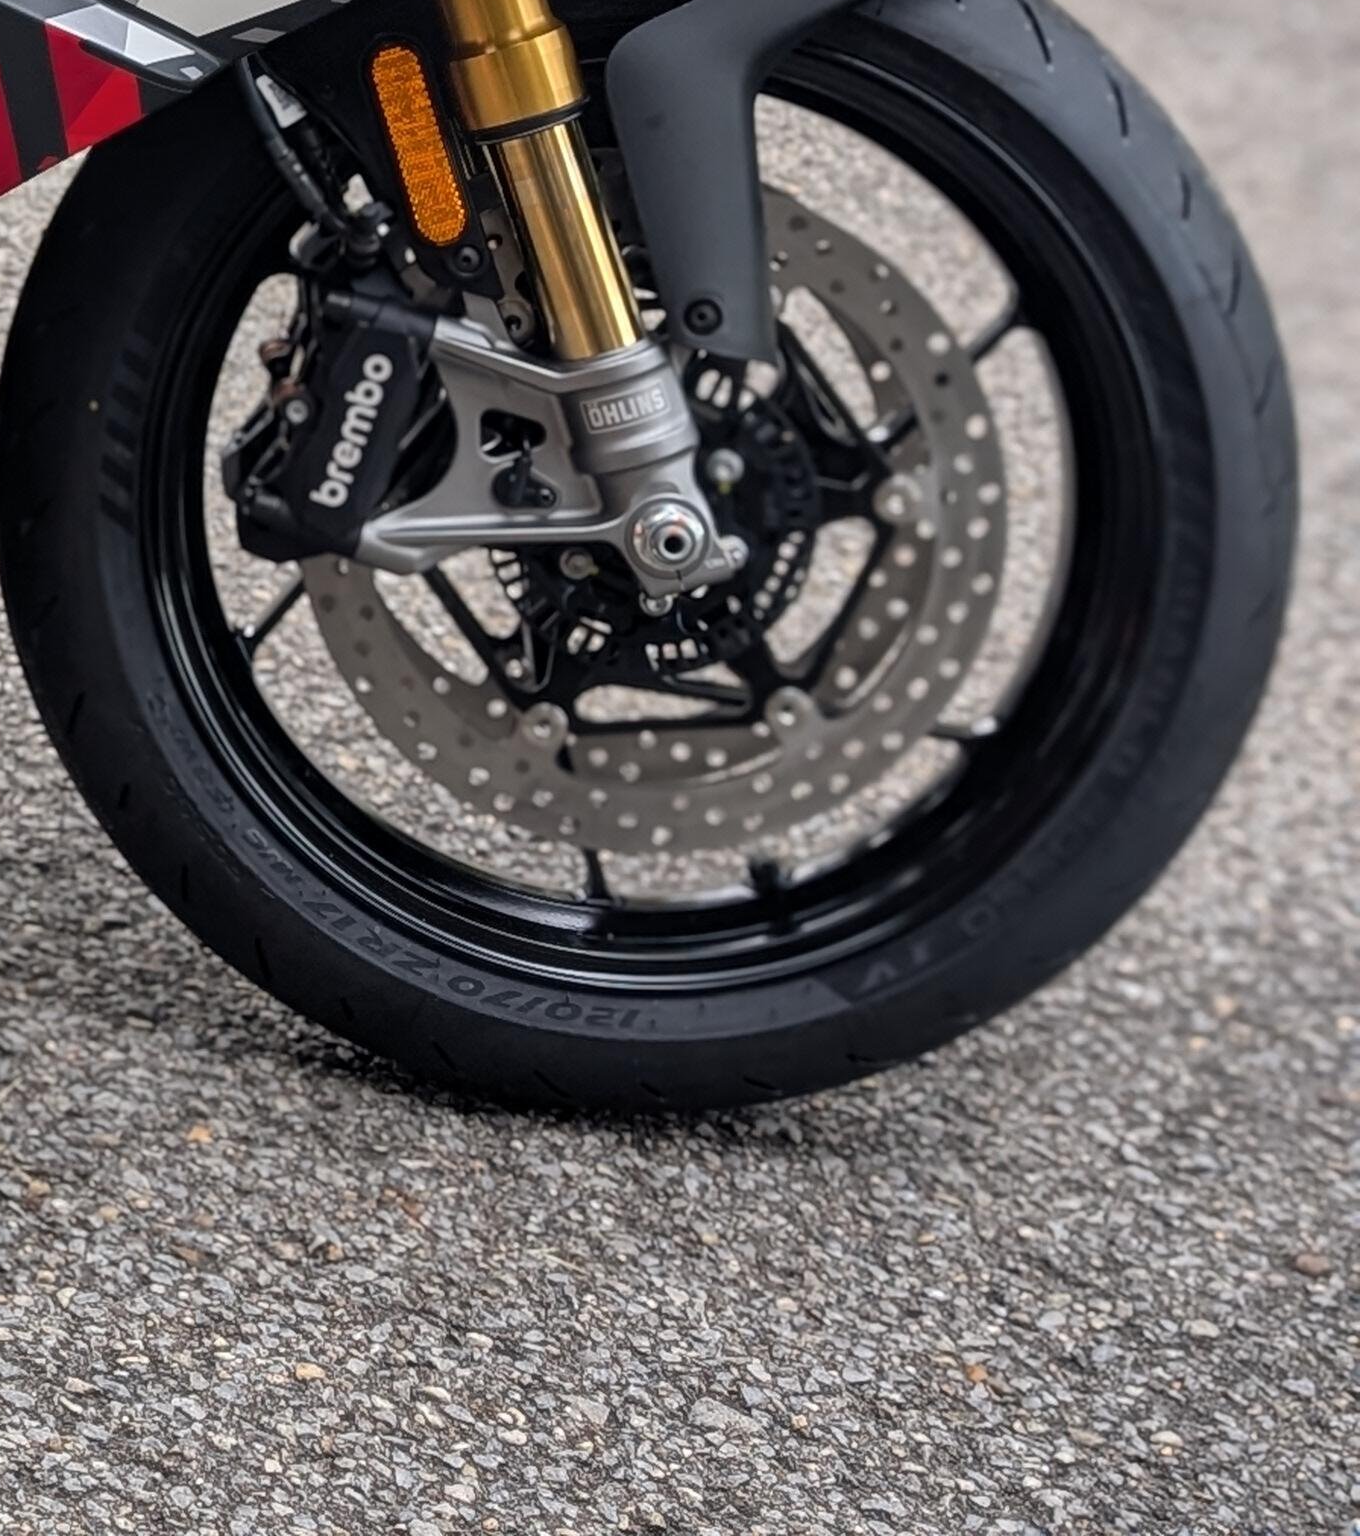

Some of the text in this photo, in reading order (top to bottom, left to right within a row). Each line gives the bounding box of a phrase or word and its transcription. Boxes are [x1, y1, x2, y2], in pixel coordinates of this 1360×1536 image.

[309, 353, 393, 508] brembo
[586, 387, 667, 429] ÖHLINS
[307, 894, 436, 979] ZR17
[442, 970, 641, 1029] 120/70
